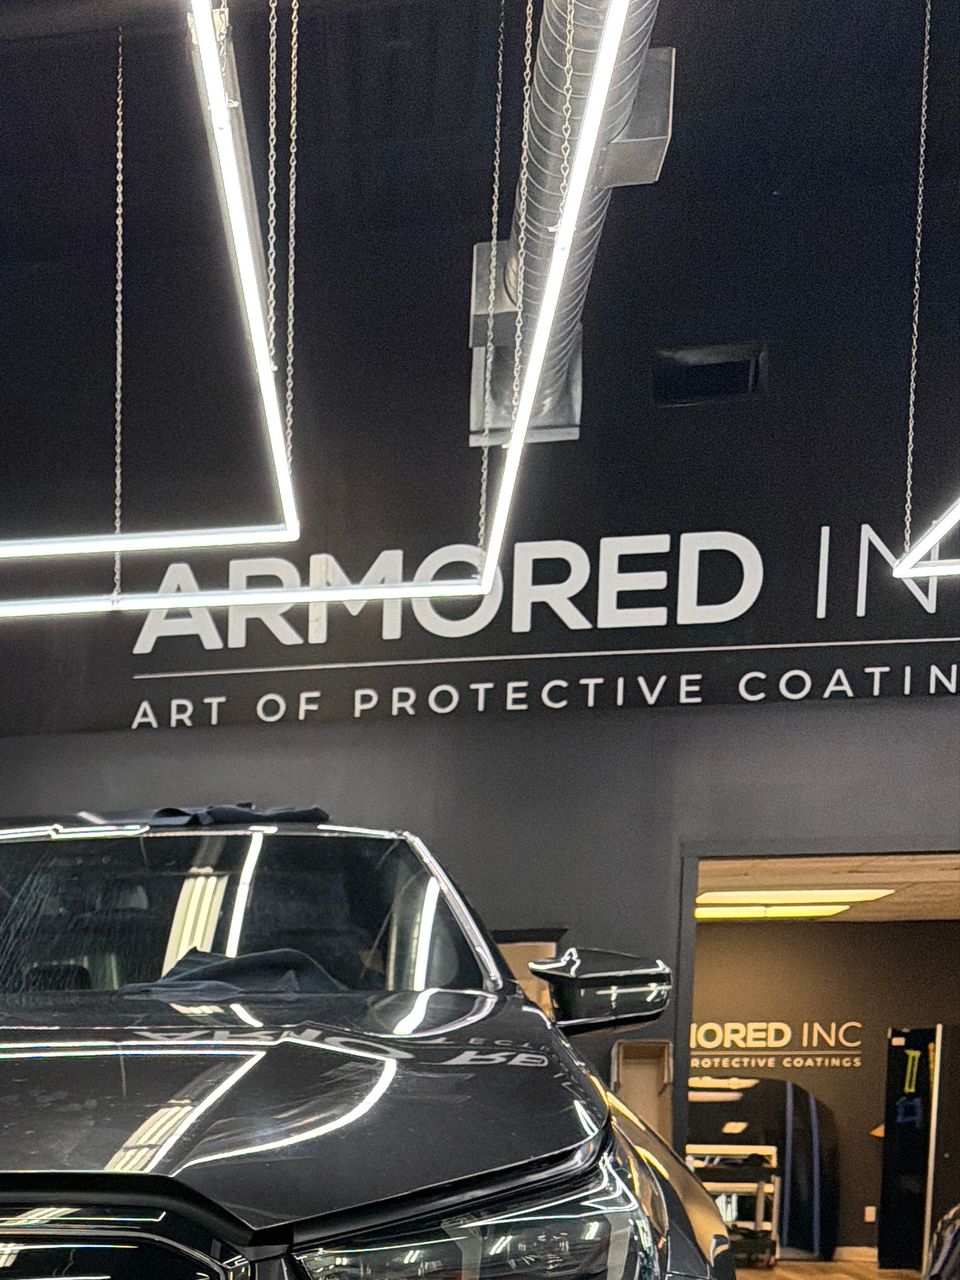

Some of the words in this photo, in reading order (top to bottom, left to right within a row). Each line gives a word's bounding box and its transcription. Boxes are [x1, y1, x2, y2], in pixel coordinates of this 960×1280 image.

[132, 531, 764, 654] ARMORED
[131, 696, 227, 730] ART
[256, 690, 321, 722] OF
[354, 674, 703, 718] PROTECTIVE
[738, 664, 958, 702] COATIN
[801, 1021, 863, 1048] INC
[782, 1057, 862, 1068] COATINGS
